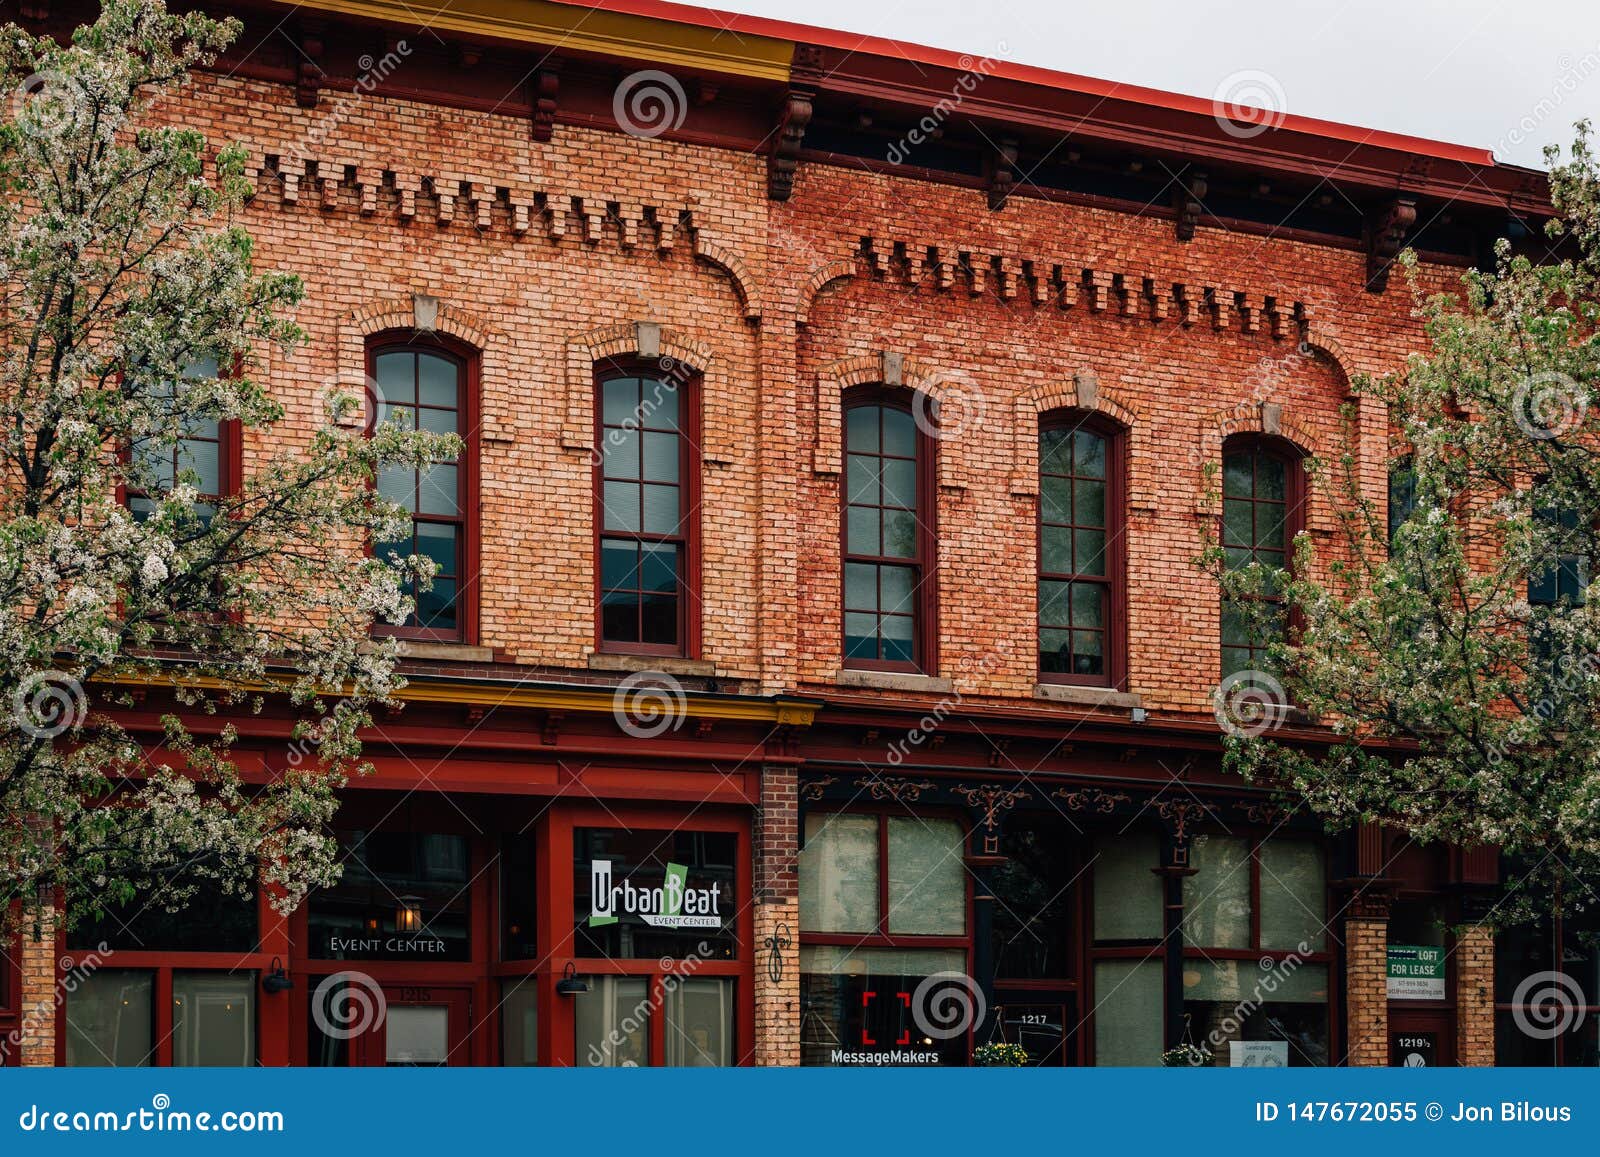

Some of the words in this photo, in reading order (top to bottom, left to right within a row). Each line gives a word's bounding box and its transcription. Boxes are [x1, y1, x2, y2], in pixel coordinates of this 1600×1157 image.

[330, 937, 381, 951] EVENT
[385, 937, 447, 953] CENTER
[1418, 950, 1438, 961] LOFT
[1391, 964, 1407, 975] FOR
[1409, 965, 1435, 976] LEASE
[1021, 1014, 1047, 1025] 1217
[830, 1048, 940, 1066] MessageMakers
